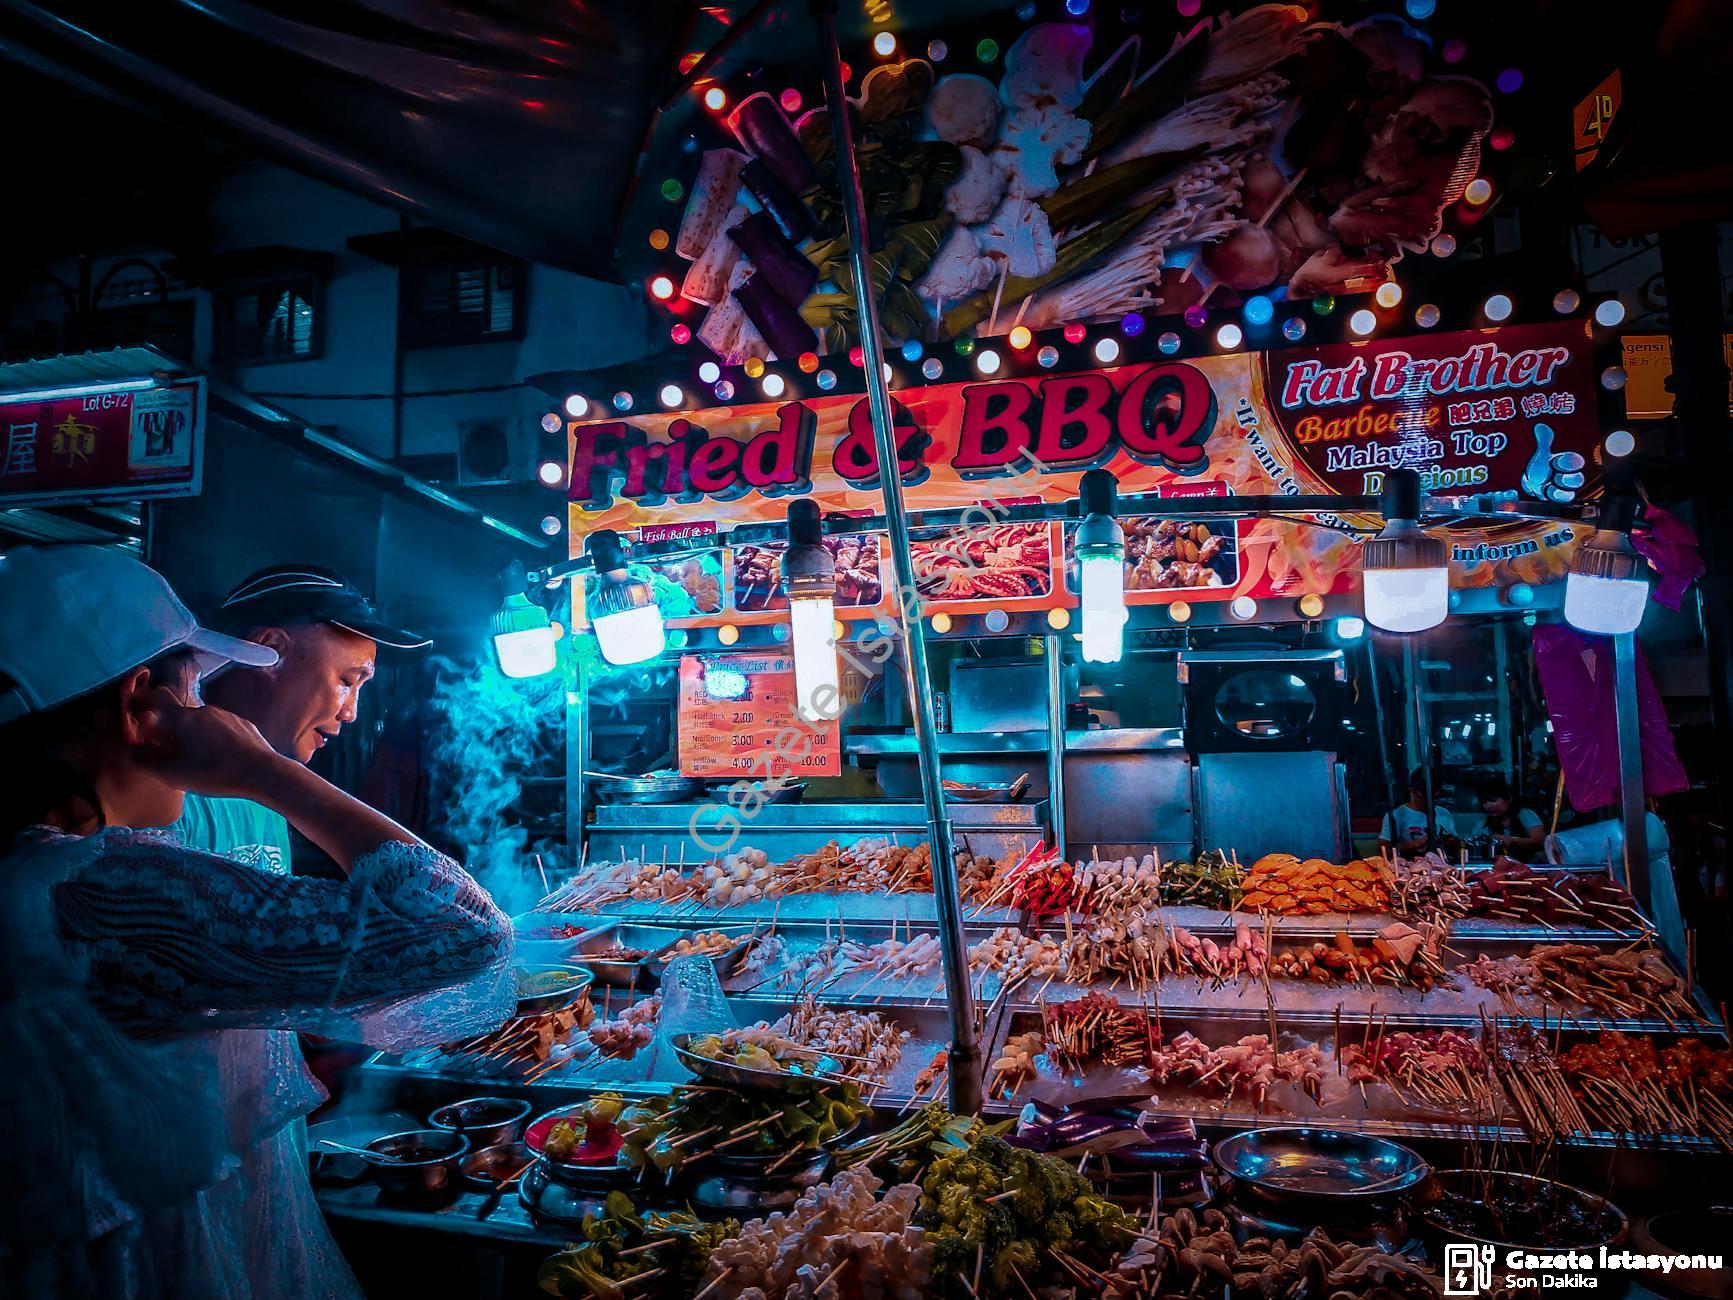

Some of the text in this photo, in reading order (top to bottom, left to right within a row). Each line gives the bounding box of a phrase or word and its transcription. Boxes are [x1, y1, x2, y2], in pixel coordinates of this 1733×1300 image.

[1282, 343, 1569, 409] Fat Brother
[83, 395, 100, 412] Lot
[102, 391, 129, 410] G-72
[1448, 397, 1516, 426] 肥兄弟
[567, 363, 1216, 504] Fried & BBQ
[1246, 427, 1287, 479] want
[1279, 477, 1300, 495] to
[1327, 430, 1507, 472] Malaysia Top
[1362, 465, 1488, 495] Dcious
[644, 527, 691, 542] Fish Ball
[1452, 527, 1575, 561] inform us
[710, 660, 768, 673] Price List
[732, 712, 753, 724] 2.00
[732, 734, 753, 746] 3.00
[732, 756, 753, 769] 4.00
